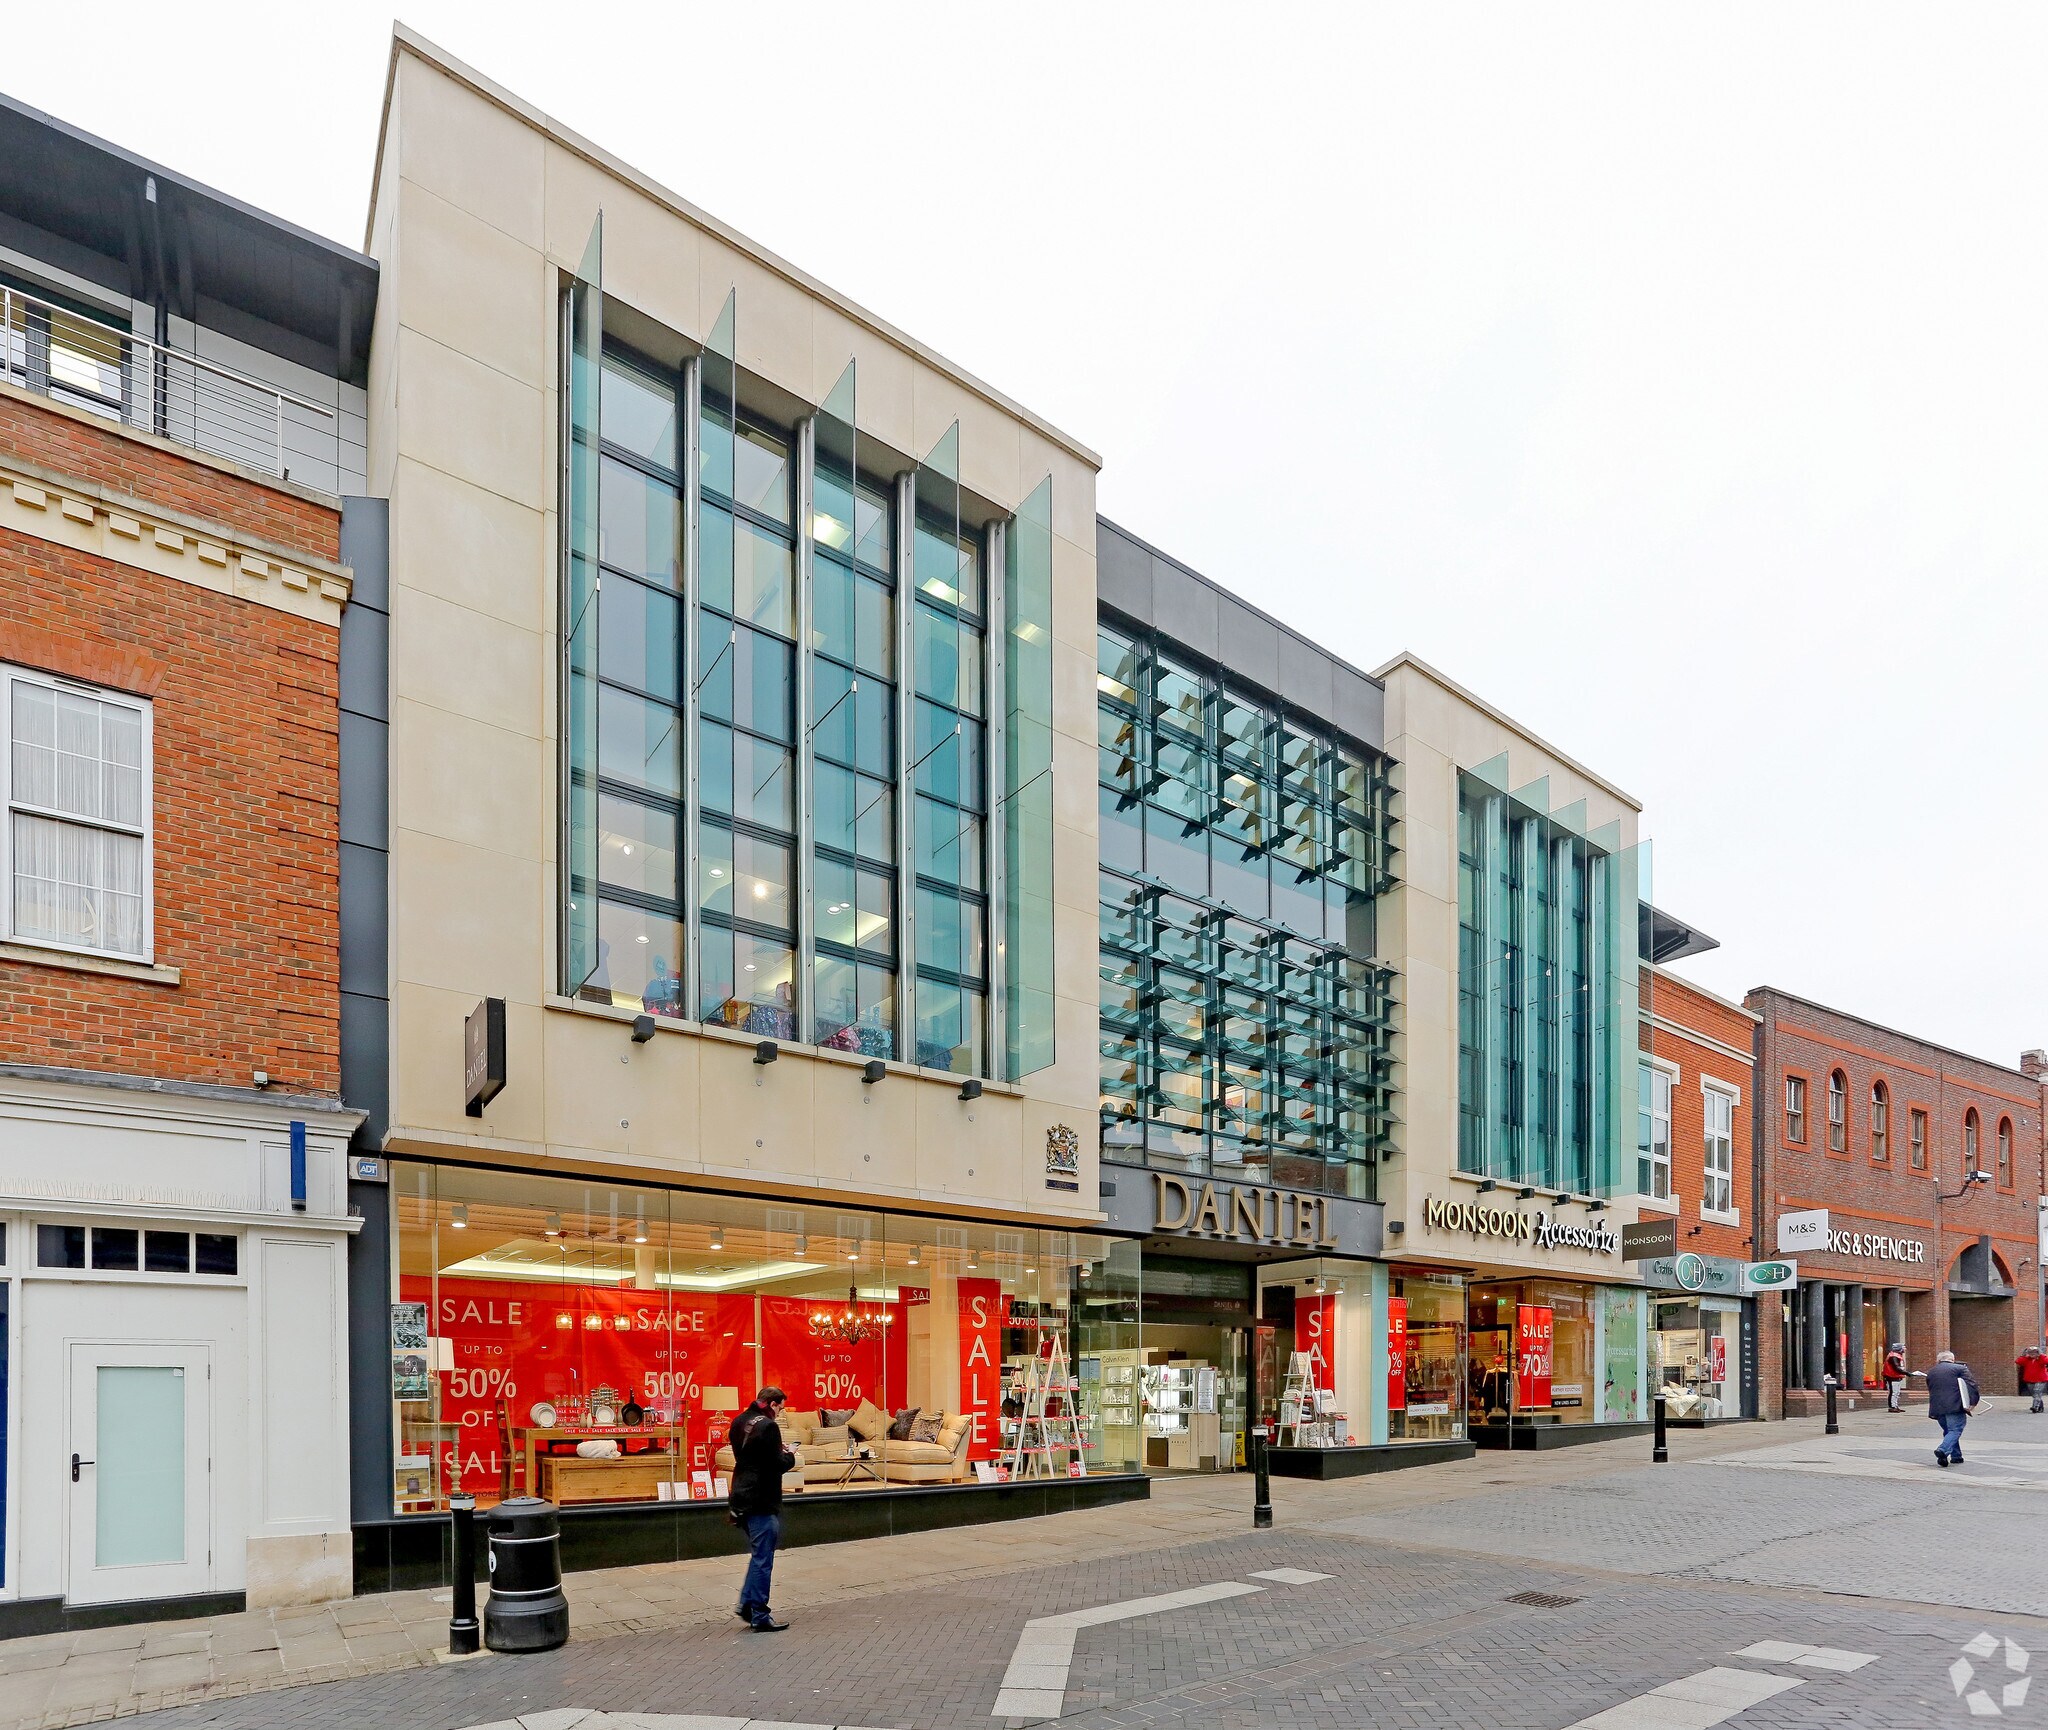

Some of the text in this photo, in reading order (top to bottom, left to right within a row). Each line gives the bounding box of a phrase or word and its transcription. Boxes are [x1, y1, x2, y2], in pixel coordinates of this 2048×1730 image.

[466, 1048, 487, 1088] DANIEL
[360, 1165, 377, 1174] ADT
[1153, 1173, 1340, 1248] DANIEL
[1425, 1197, 1620, 1255] MONSOON Accessorize
[1788, 1222, 1817, 1234] M&S
[1624, 1234, 1672, 1246] MONSOON
[1822, 1229, 1924, 1263] RKS & SPENCER
[1654, 1259, 1673, 1275] Crafts
[1681, 1260, 1702, 1283] C&H
[1706, 1266, 1724, 1281] Home
[1754, 1266, 1787, 1280] C&H
[913, 1289, 930, 1300] SAL
[442, 1299, 522, 1325] SALE
[637, 1308, 705, 1331] SALE
[1388, 1318, 1403, 1334] LE
[1522, 1324, 1550, 1339] SALE
[464, 1346, 503, 1355] UP TO
[1308, 1311, 1327, 1368] SA
[655, 1351, 688, 1359] UP TO
[839, 1355, 852, 1363] TO
[1522, 1354, 1550, 1377] 70%
[967, 1296, 991, 1444] SALE
[450, 1368, 517, 1398] 50%
[644, 1371, 700, 1399] 50%
[814, 1374, 861, 1399] 50%
